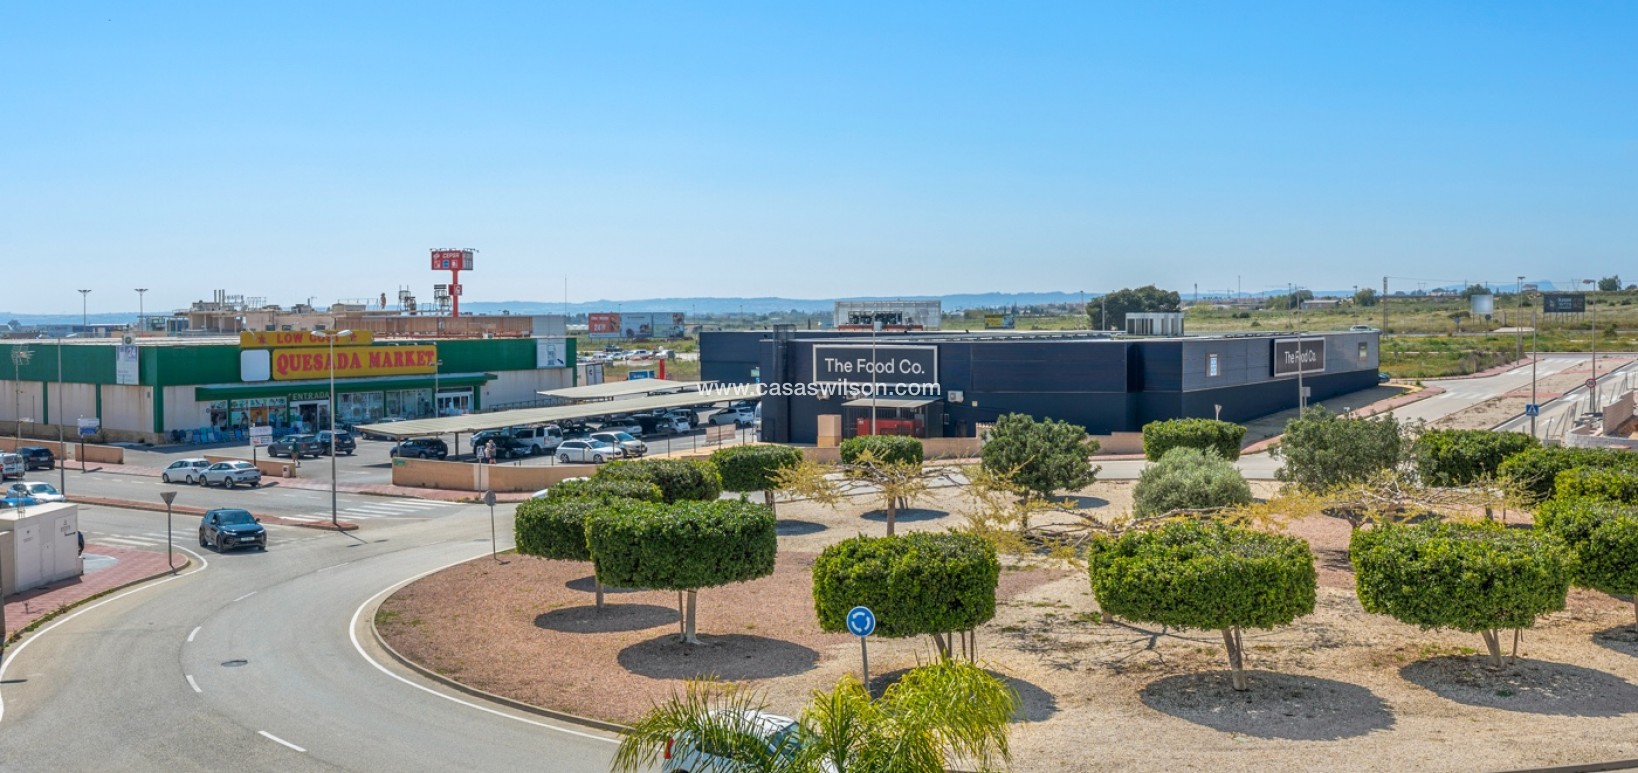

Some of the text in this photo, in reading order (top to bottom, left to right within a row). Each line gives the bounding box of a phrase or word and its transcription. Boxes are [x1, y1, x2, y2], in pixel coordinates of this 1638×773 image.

[276, 333, 303, 344] LOW
[276, 350, 435, 375] QUESADA MARKET
[1284, 351, 1295, 364] The
[1295, 350, 1308, 363] Fod
[825, 358, 925, 374] The Food Co.
[292, 391, 330, 401] ENTRADA
